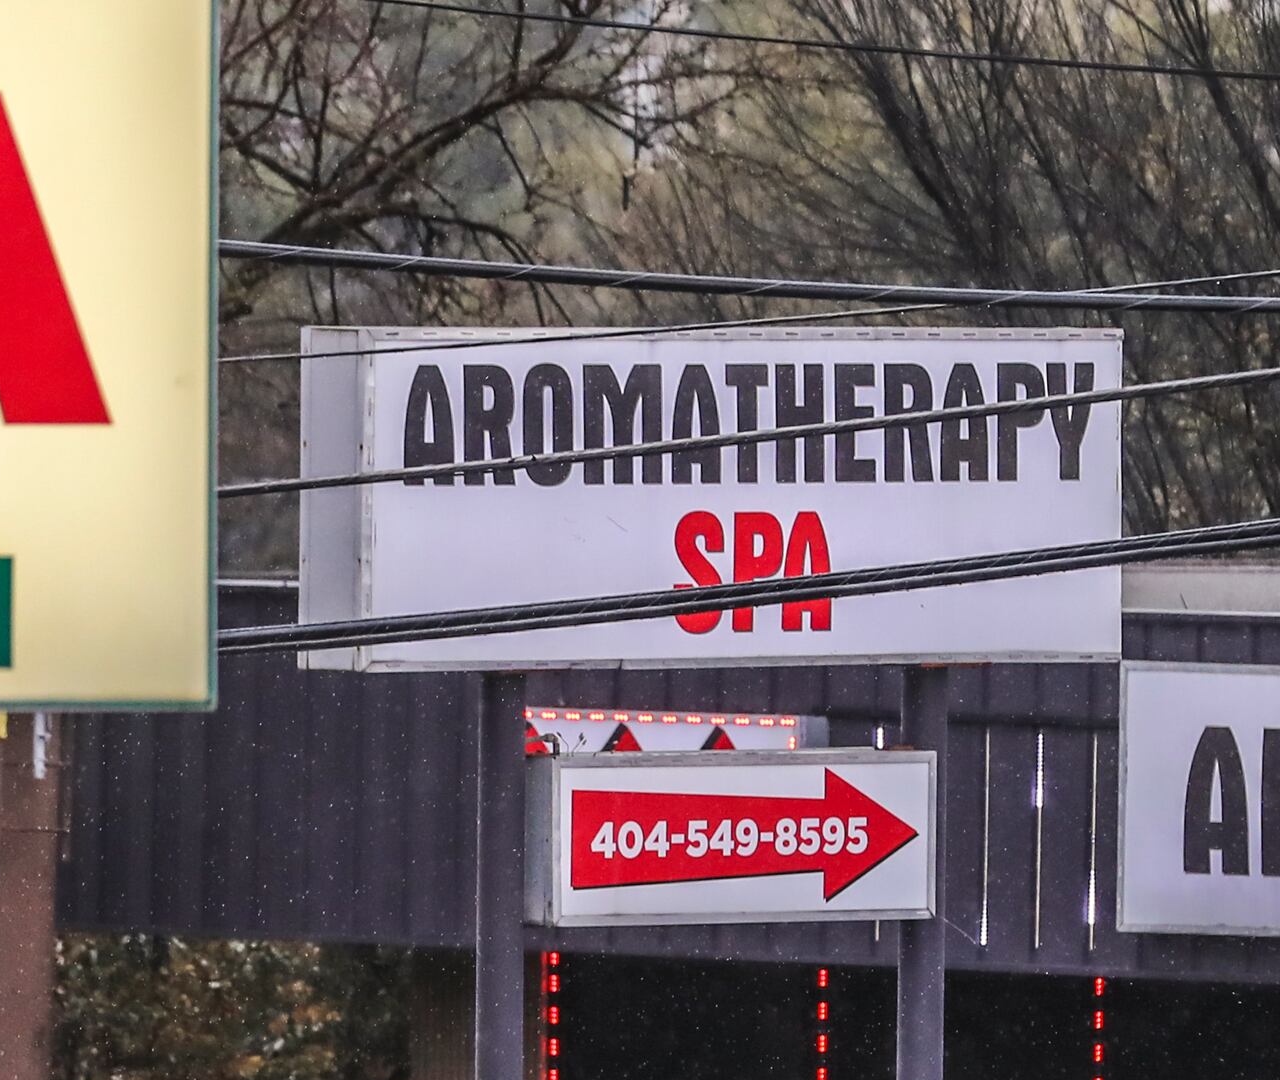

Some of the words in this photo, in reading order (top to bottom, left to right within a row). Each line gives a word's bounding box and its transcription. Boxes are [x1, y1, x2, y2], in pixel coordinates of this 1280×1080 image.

[402, 361, 1097, 487] AROMATHERAPY
[672, 510, 833, 636] SPA
[590, 816, 869, 860] 404-549-8595
